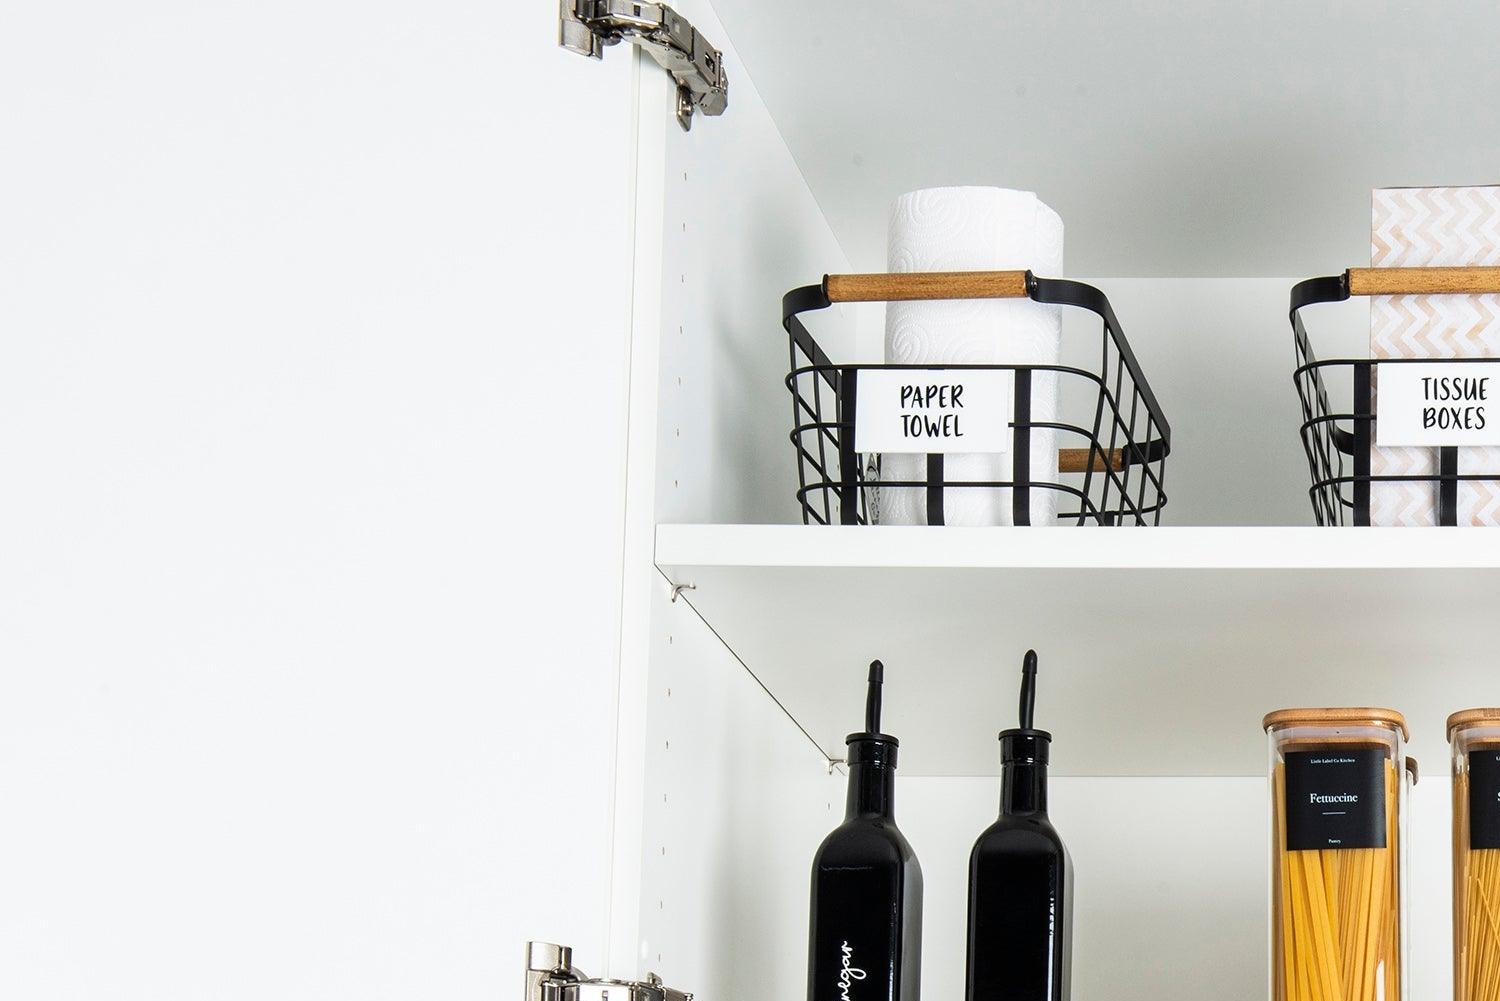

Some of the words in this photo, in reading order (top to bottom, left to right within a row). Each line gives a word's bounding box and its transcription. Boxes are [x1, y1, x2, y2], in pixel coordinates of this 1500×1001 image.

[900, 385, 964, 409] PAPER
[1421, 377, 1490, 401] TISSUE
[900, 414, 964, 438] TOWEL
[1422, 406, 1486, 430] BOXES
[1310, 792, 1358, 803] Fettuccine
